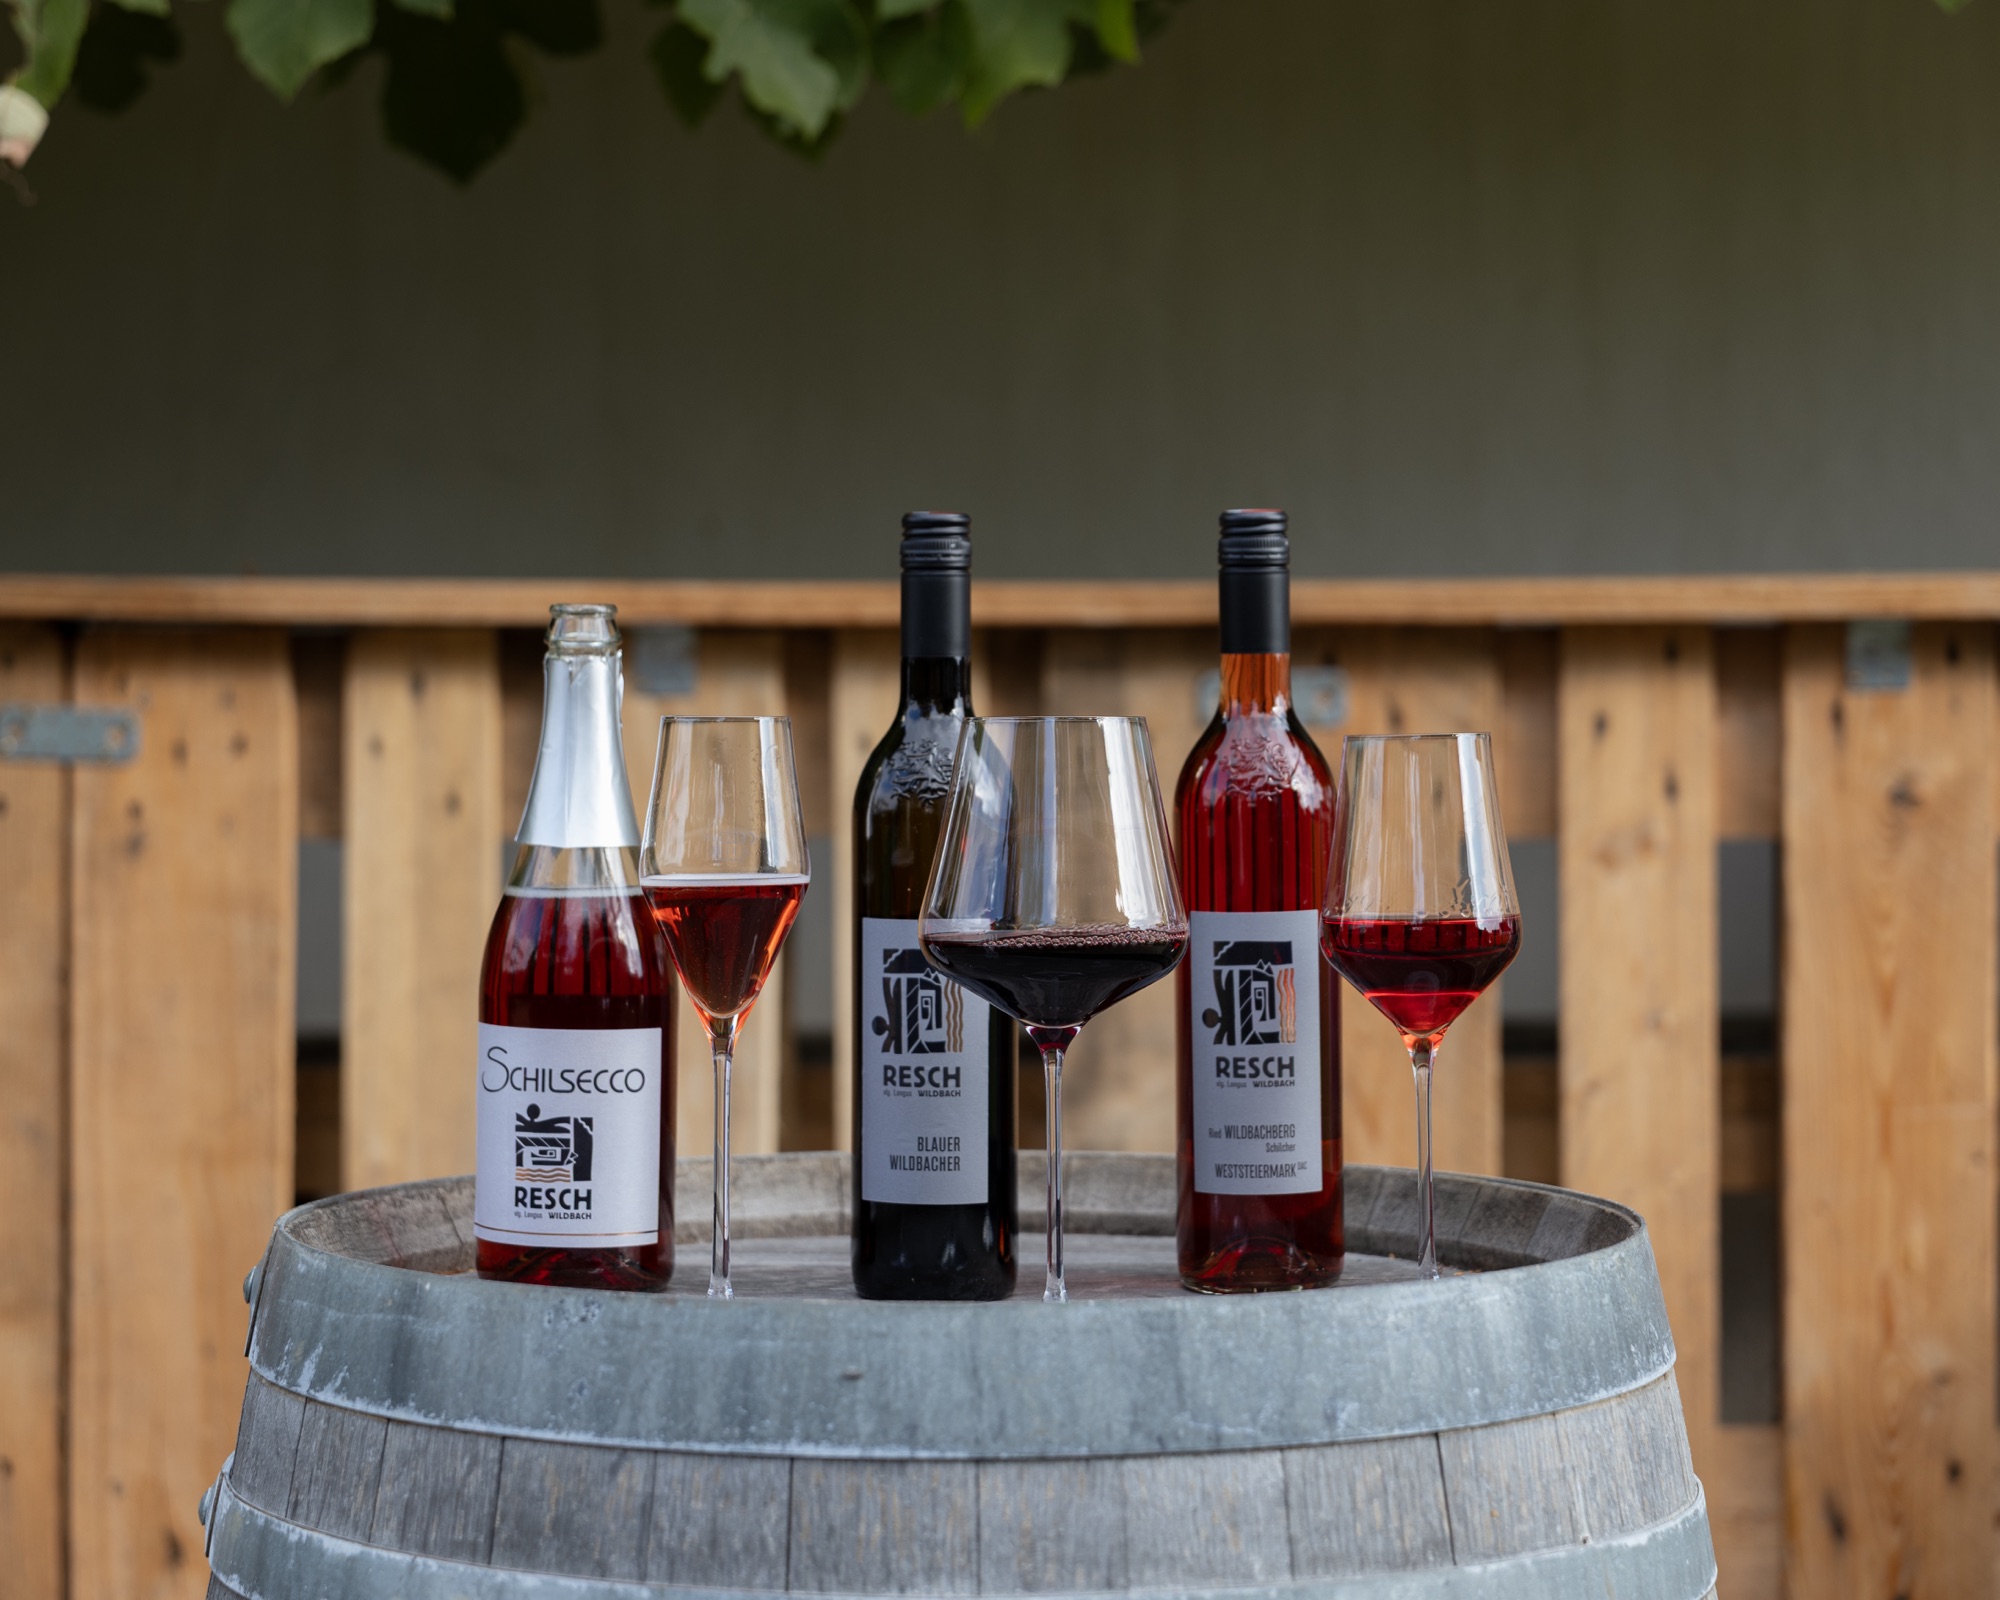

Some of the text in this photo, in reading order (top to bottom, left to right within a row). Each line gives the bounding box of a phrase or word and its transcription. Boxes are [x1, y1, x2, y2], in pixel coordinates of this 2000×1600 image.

[1215, 1056, 1295, 1079] RESCH
[883, 1064, 962, 1089] RESCH
[1252, 1079, 1296, 1088] WILDBACH
[917, 1090, 961, 1098] WILDBACH
[1208, 1123, 1296, 1140] Ried WILDBACHBERG
[917, 1136, 961, 1152] BLAUER
[1265, 1142, 1296, 1153] Schilcher
[889, 1154, 961, 1172] WILDBACHER
[1214, 1162, 1297, 1179] WESTSTEIERMARK
[514, 1186, 592, 1210] RESCH
[548, 1211, 592, 1220] WILDBACH
